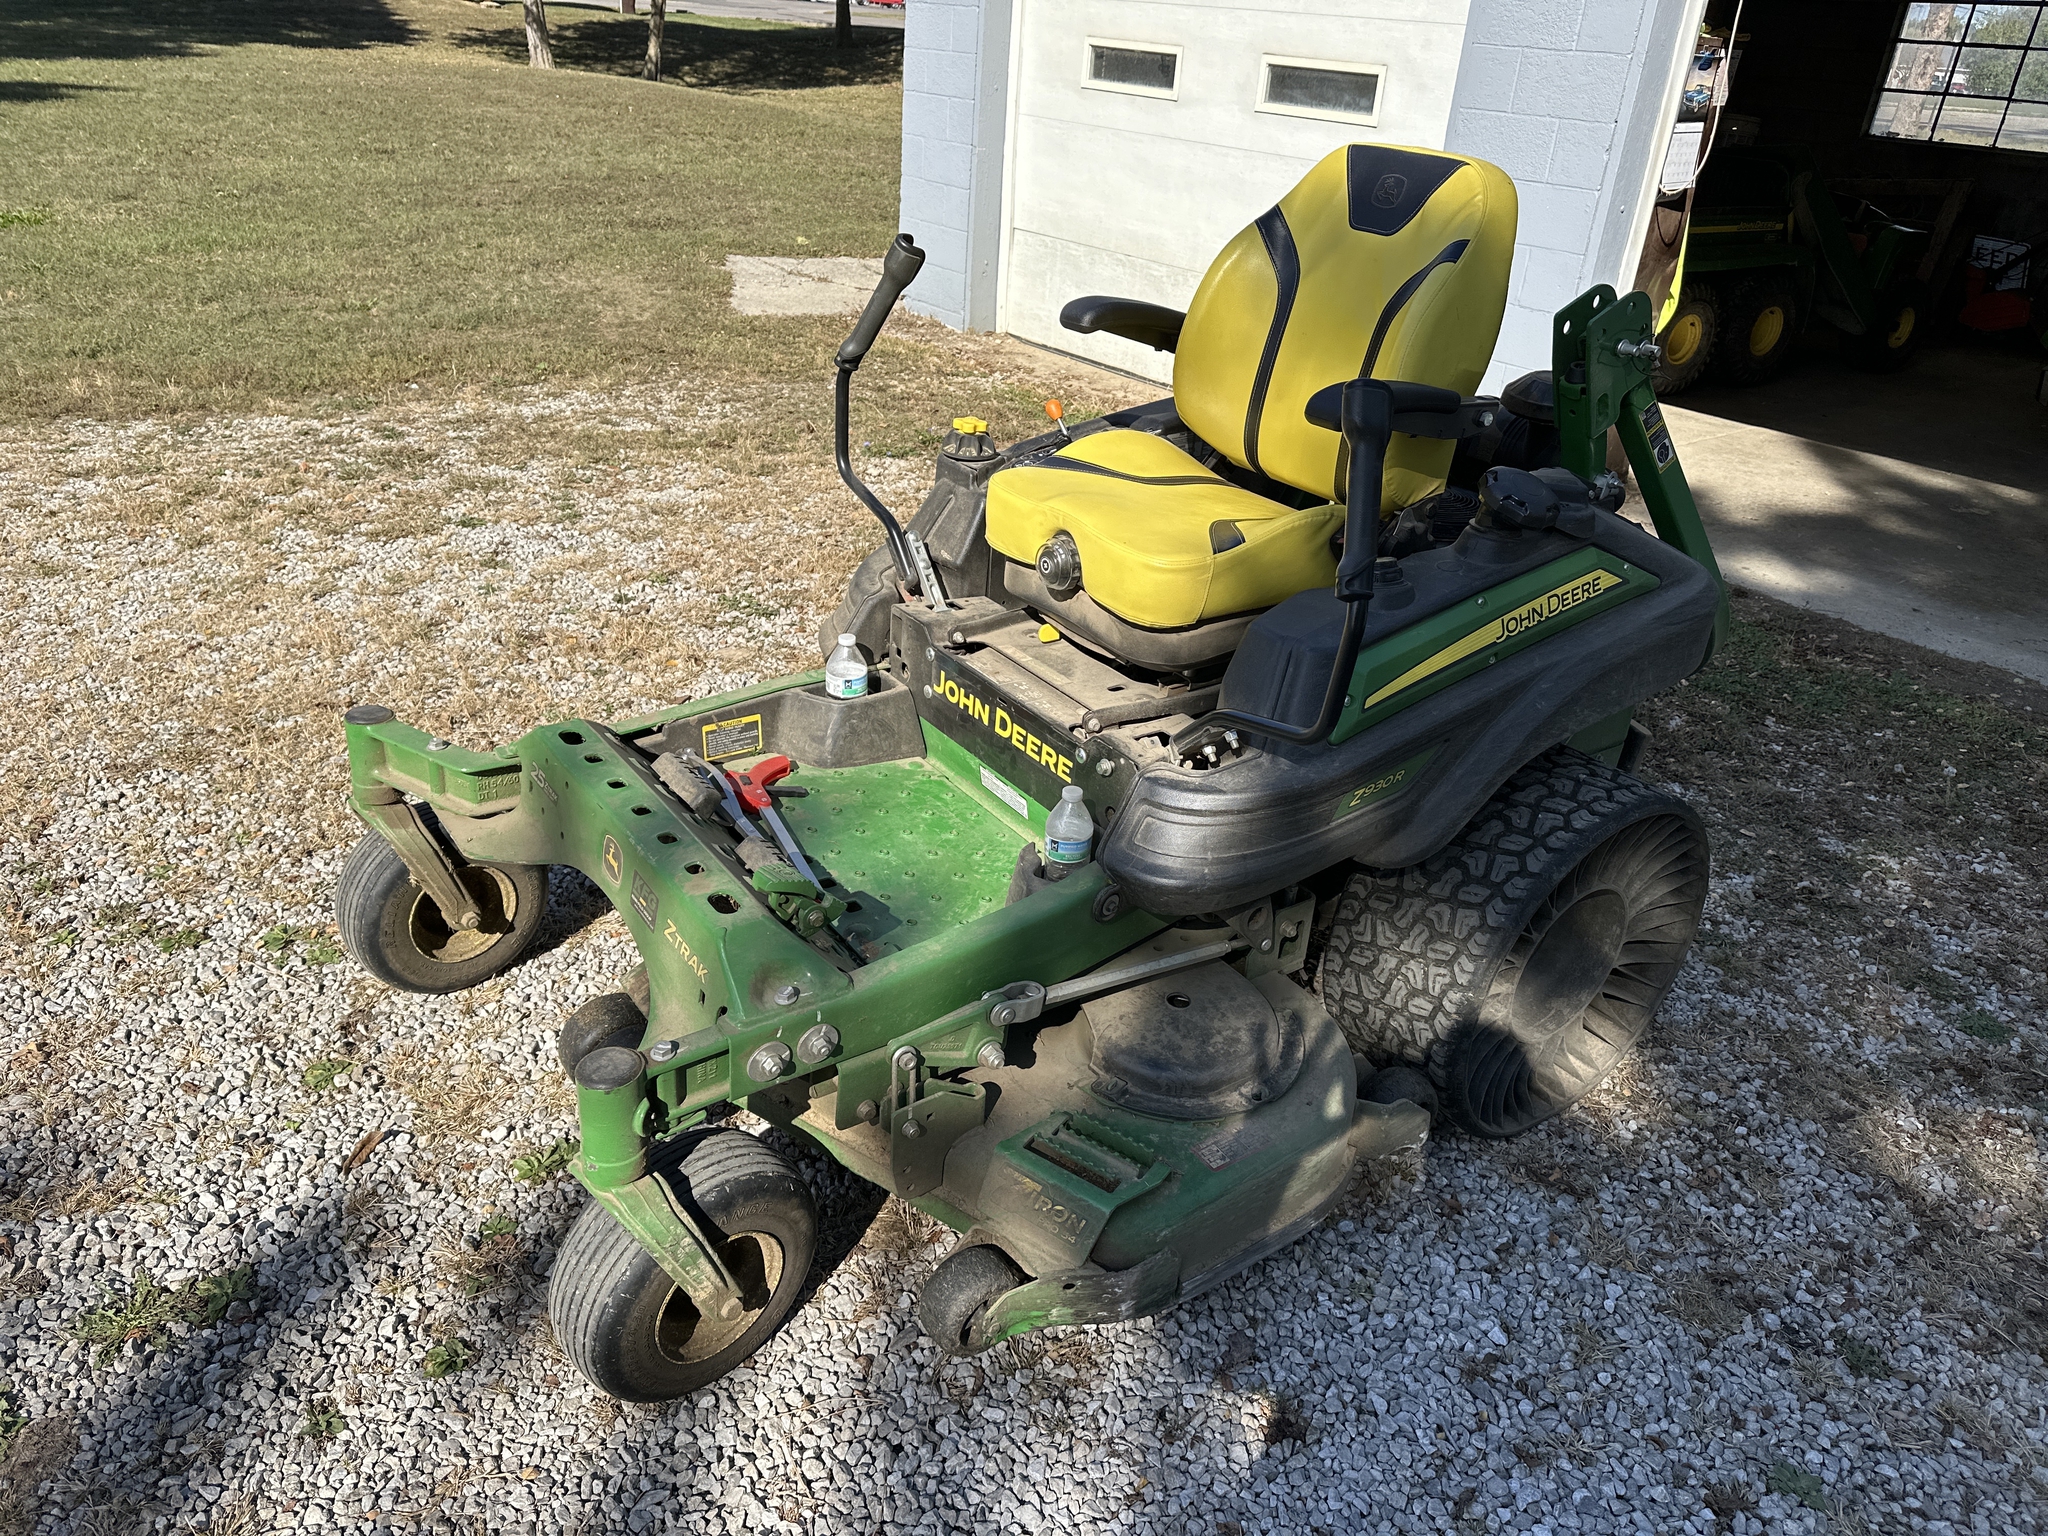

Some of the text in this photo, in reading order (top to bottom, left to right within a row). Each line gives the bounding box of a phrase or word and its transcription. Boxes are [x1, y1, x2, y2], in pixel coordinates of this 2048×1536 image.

[1495, 575, 1603, 642] JOHN DEERE
[722, 719, 743, 728] CAUTION
[933, 670, 990, 726] JOHN
[994, 706, 1074, 784] DEERE
[530, 761, 546, 788] 25
[1348, 769, 1406, 807] Z930R
[631, 874, 659, 909] KFG
[663, 918, 709, 984] ZTRAK
